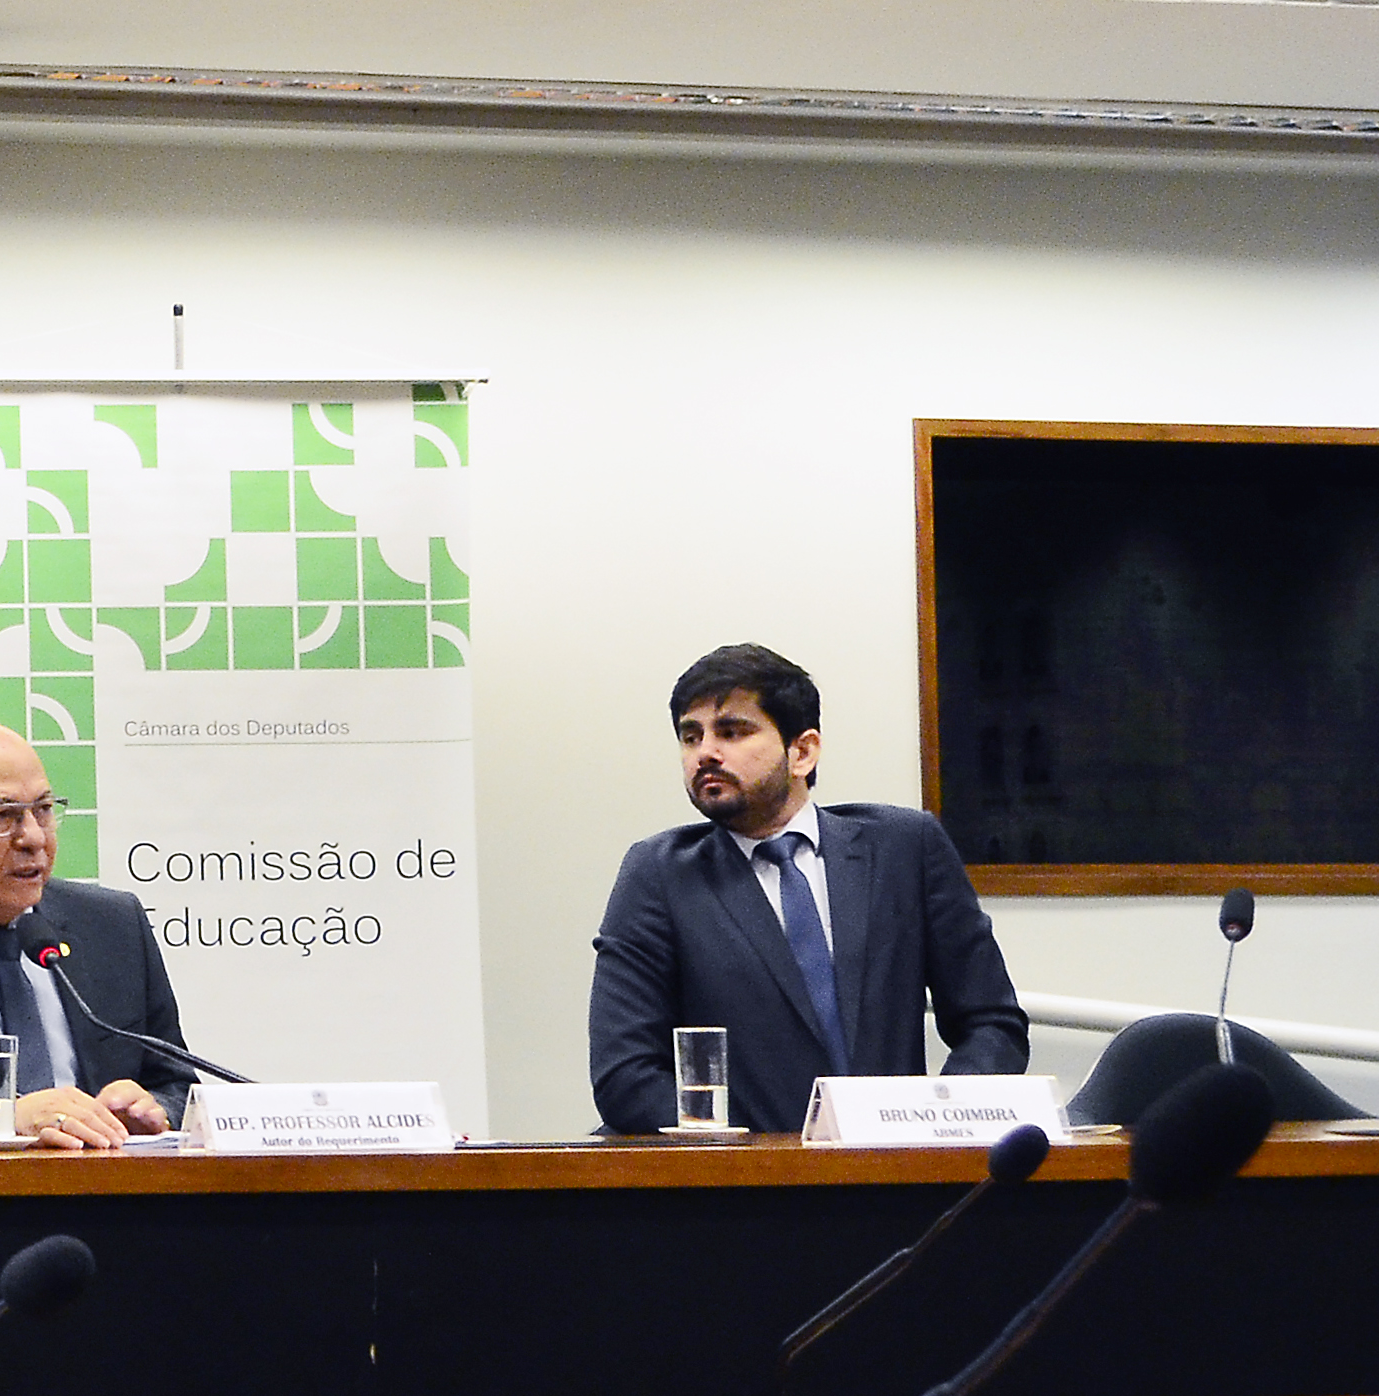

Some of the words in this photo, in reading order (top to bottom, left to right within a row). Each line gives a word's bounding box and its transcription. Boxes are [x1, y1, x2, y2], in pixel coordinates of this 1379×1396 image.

[124, 720, 200, 737] Câmara
[206, 720, 240, 736] dos
[246, 719, 350, 738] Deputados
[127, 841, 376, 882] Comissão
[396, 839, 456, 879] de
[215, 1116, 256, 1131] DEP.
[261, 1115, 361, 1130] PROFESSOR
[367, 1113, 435, 1129] ALCIDES
[879, 1108, 936, 1122] BRUNO
[942, 1108, 1018, 1121] COIMBRA
[261, 1136, 293, 1147] Autor
[297, 1135, 313, 1147] do
[317, 1135, 400, 1147] Requerimento
